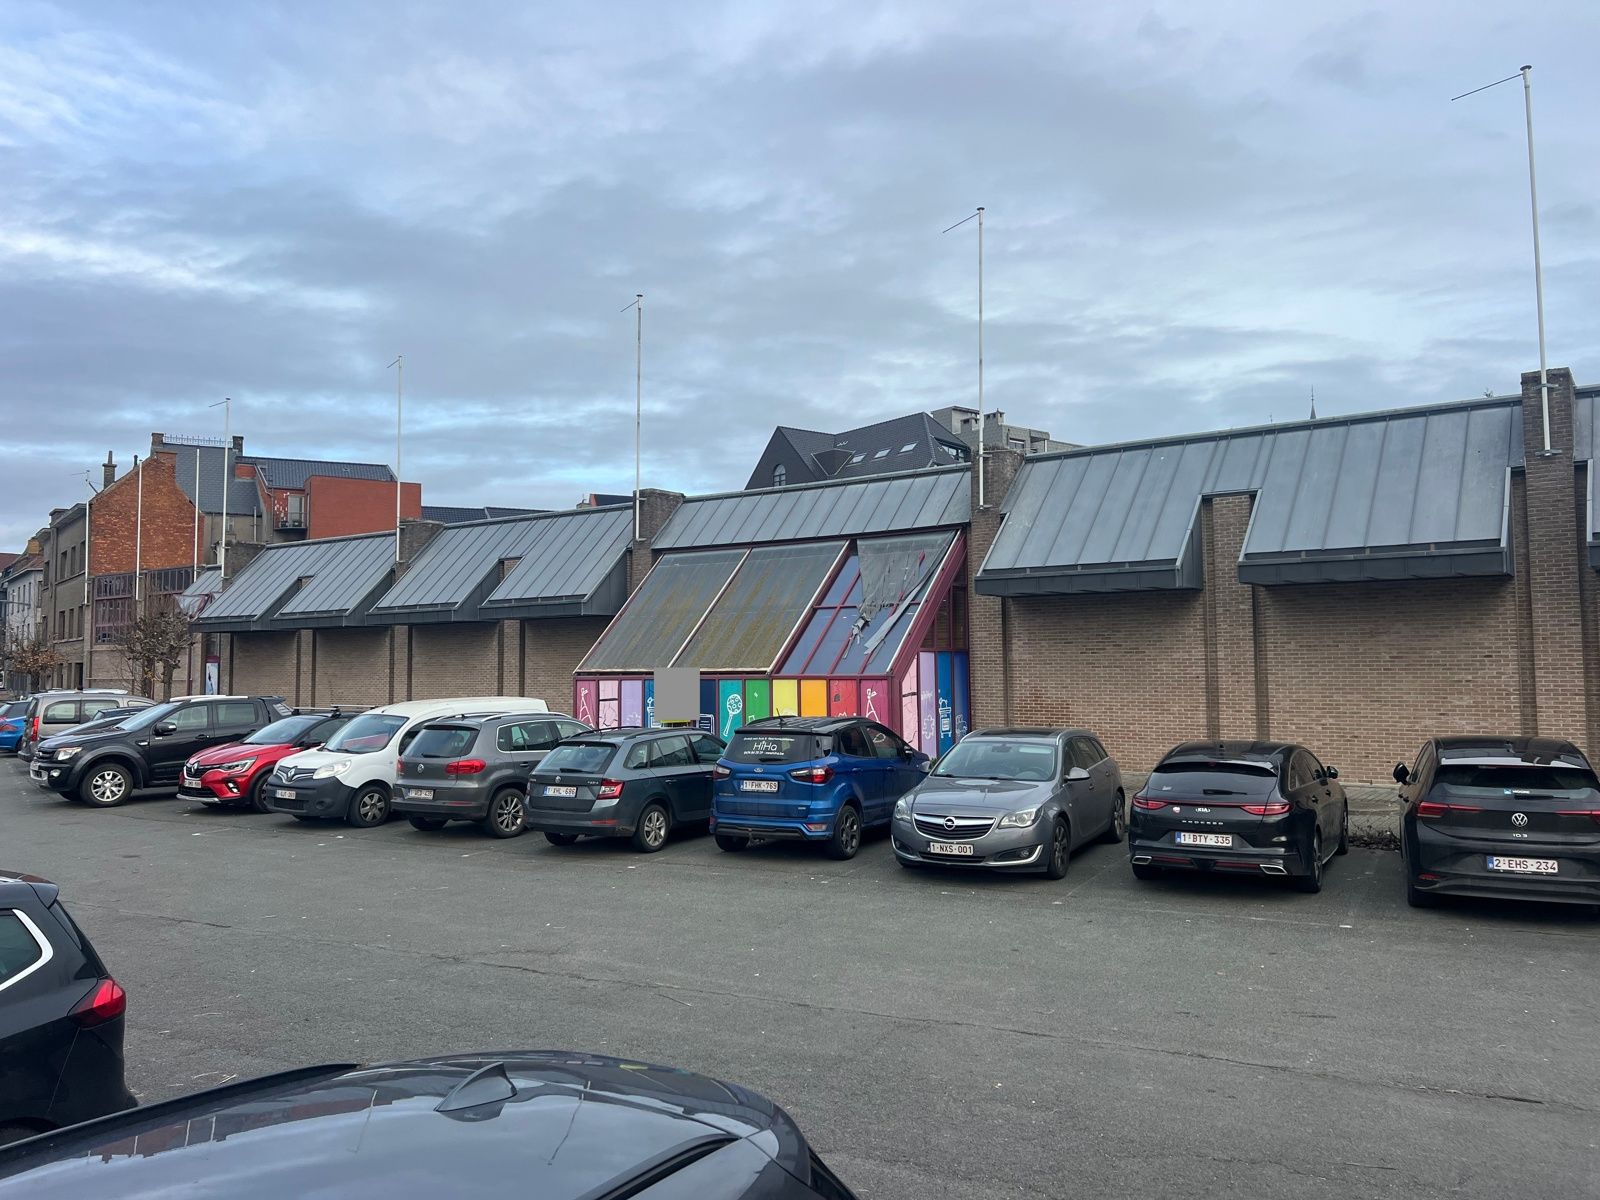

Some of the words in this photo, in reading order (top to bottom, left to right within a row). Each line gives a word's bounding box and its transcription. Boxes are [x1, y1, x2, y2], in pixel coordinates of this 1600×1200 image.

[1182, 834, 1230, 844] 1-BTY-335
[932, 844, 972, 853] 1-NXS-001
[1494, 858, 1556, 871] 2-EHS-234
